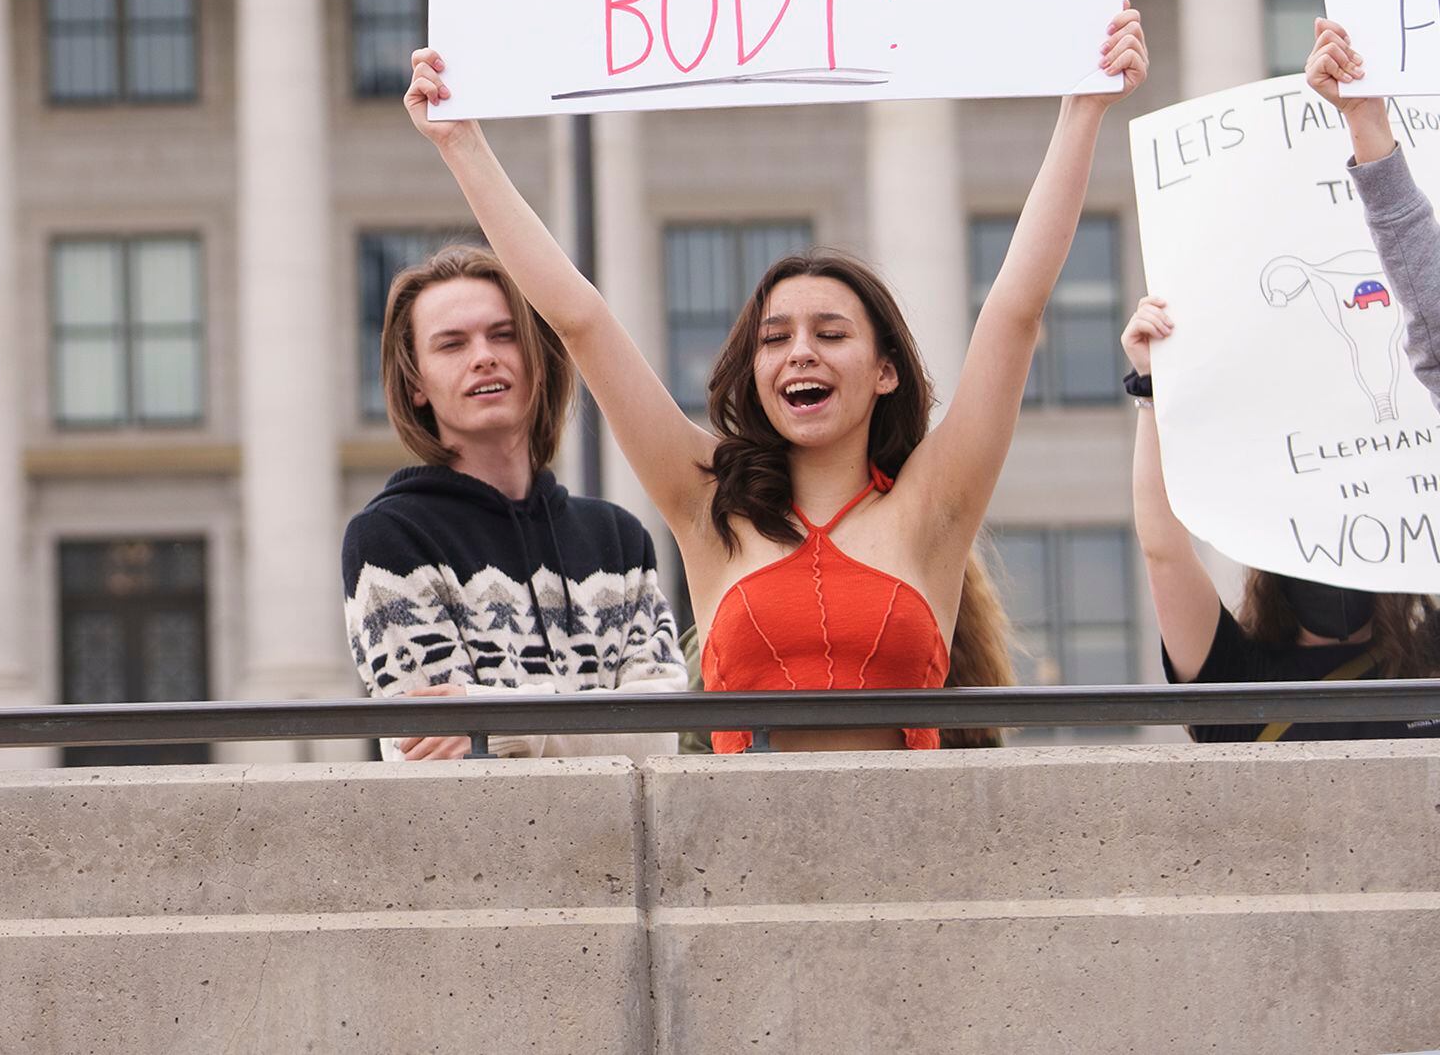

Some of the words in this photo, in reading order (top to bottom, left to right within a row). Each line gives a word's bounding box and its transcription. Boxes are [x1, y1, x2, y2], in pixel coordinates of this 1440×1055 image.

[1152, 108, 1247, 190] LETS
[1386, 96, 1440, 148] ABO
[1287, 425, 1440, 474] ELEPHAN
[1340, 481, 1369, 498] IN
[1290, 514, 1440, 567] WOM
